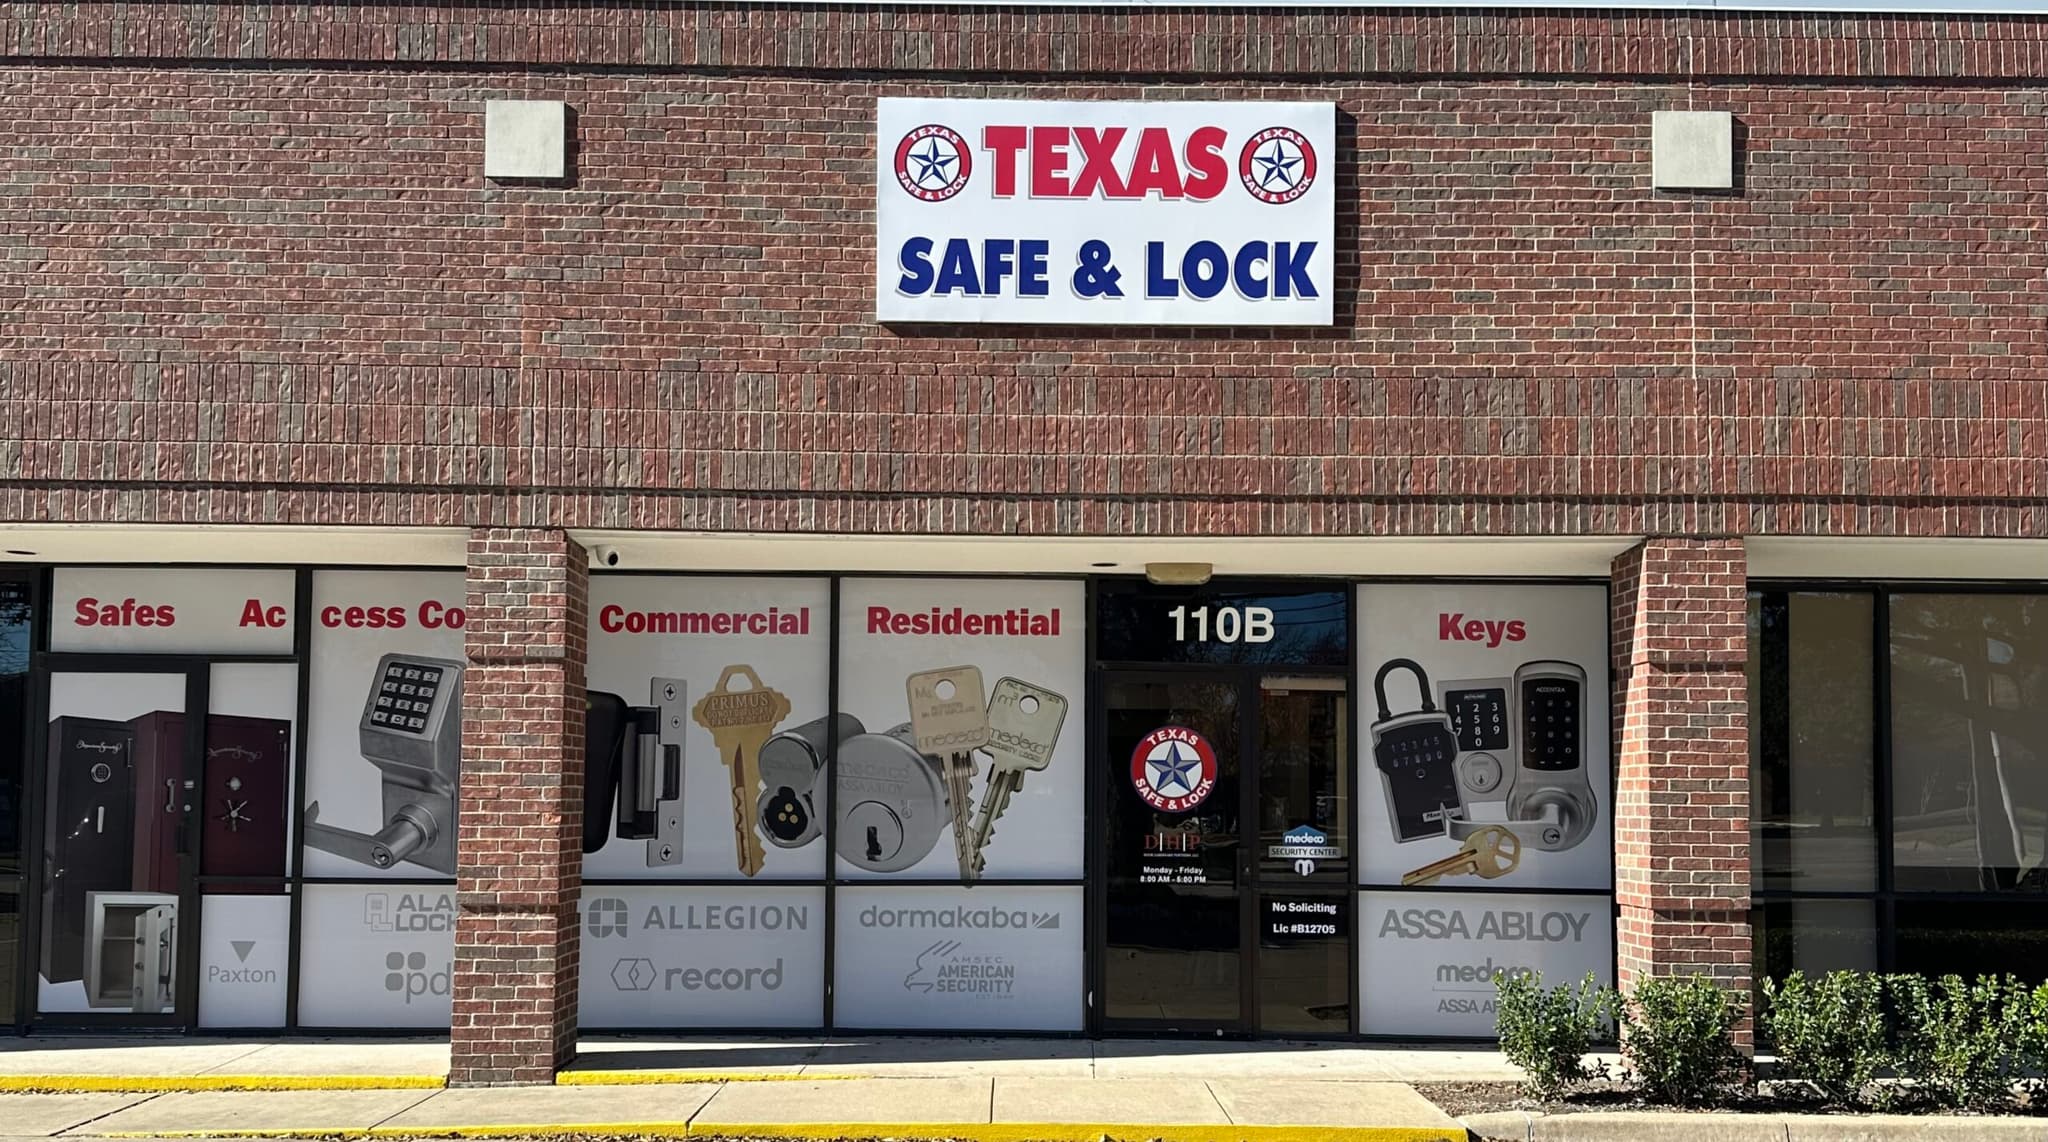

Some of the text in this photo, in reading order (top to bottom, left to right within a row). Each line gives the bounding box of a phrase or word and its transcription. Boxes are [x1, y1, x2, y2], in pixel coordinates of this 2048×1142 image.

[909, 127, 960, 144] TEXAS
[1253, 129, 1305, 145] TEXAS
[983, 125, 1229, 201] TEXAS
[899, 171, 922, 197] SAFE
[938, 174, 967, 199] LOCK
[1243, 174, 1267, 199] SAFE
[1283, 176, 1312, 201] LOCK
[898, 237, 1318, 300] SAFE & LOCK
[76, 598, 175, 627] Safes
[240, 600, 286, 628] Ac
[321, 604, 406, 629] cess
[599, 605, 809, 635] Commercial
[867, 606, 1060, 636] Residential
[1168, 605, 1275, 643] 110B
[1439, 614, 1526, 648] Keys
[711, 692, 769, 710] PRIMUS
[1455, 702, 1498, 713] 1 2 3
[1455, 714, 1499, 724] 4 5 6
[1147, 729, 1199, 745] TEXAS
[1474, 726, 1481, 736] 8
[1493, 725, 1500, 735] 9
[1475, 738, 1482, 747] 0
[1136, 778, 1213, 810] SAFE & LOCK
[1284, 832, 1325, 844] medeco
[1271, 847, 1337, 857] SECURITY CENTER
[1143, 866, 1173, 875] Monday
[1179, 866, 1203, 876] Friday
[1157, 875, 1170, 883] AM
[859, 905, 1028, 930] dormakaba
[1272, 902, 1337, 915] No Soliciting
[643, 905, 808, 931] ALLEGION
[1379, 909, 1590, 941] ASSA ABLOY
[1272, 923, 1336, 934] Lic #B12705
[950, 956, 1004, 964] AMSEC
[207, 965, 277, 984] Paxton
[665, 958, 784, 991] record
[937, 965, 1015, 978] AMERICAN
[937, 979, 1015, 993] SECURITY
[1437, 999, 1480, 1014] ASSA
